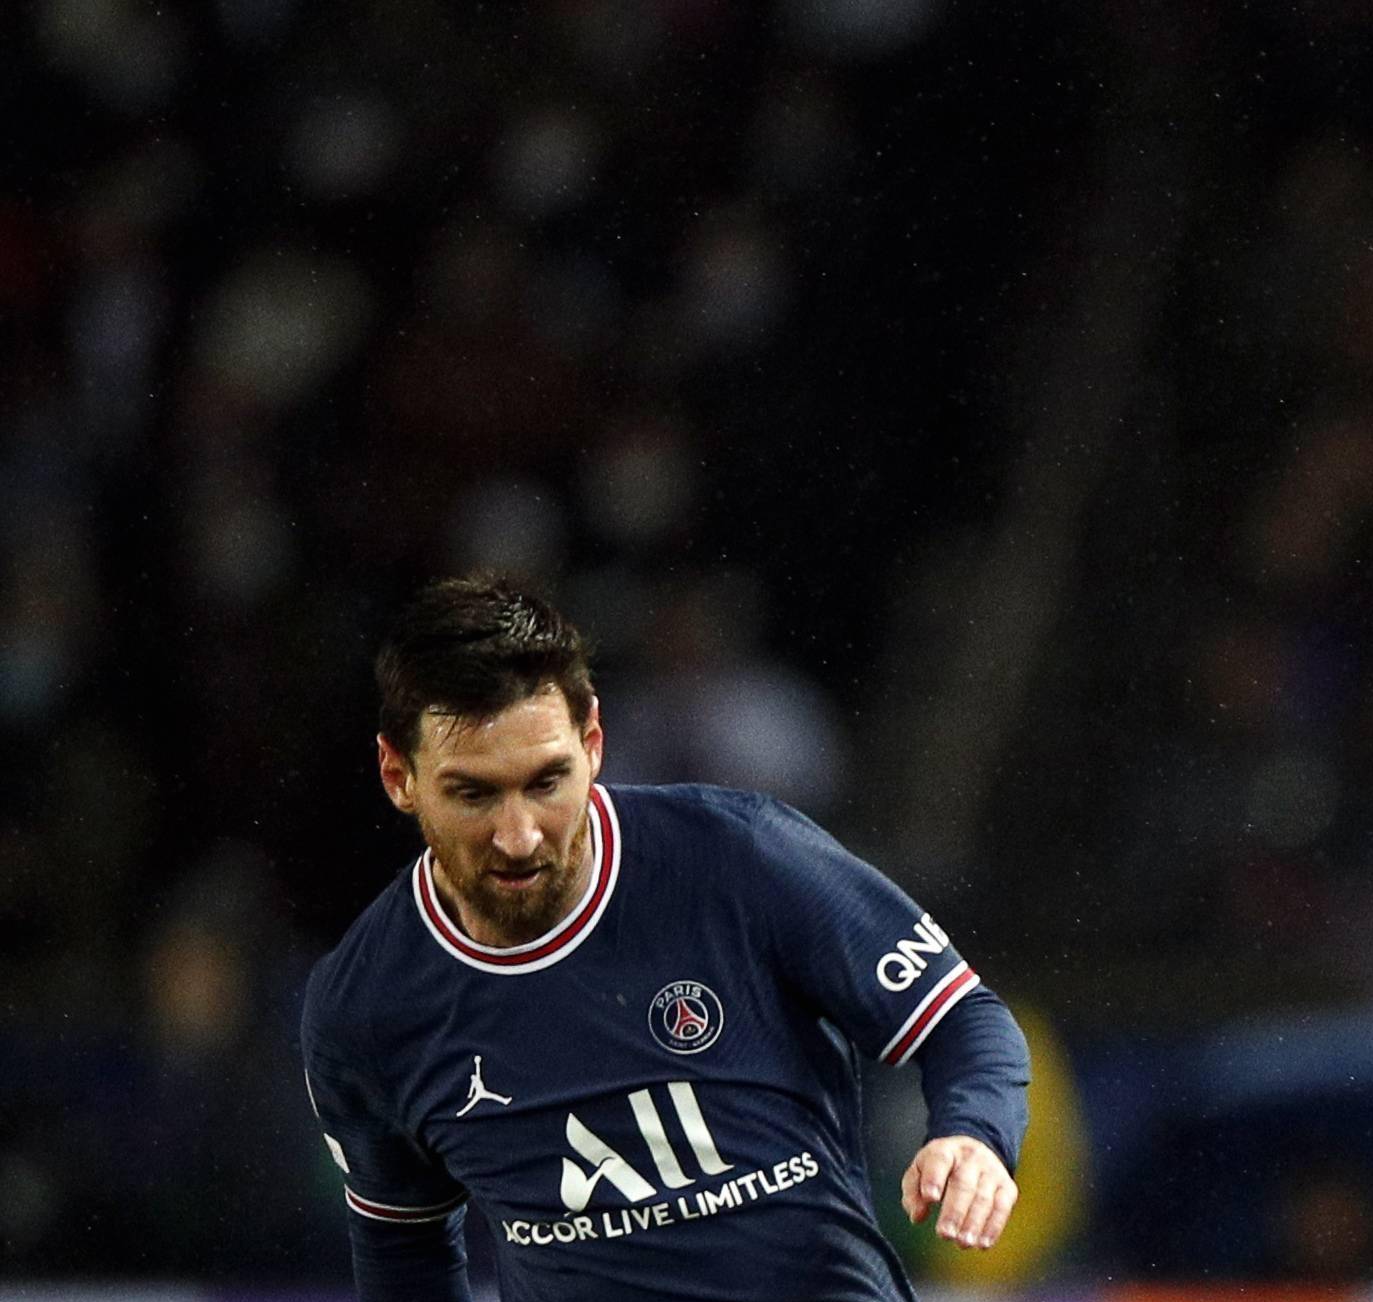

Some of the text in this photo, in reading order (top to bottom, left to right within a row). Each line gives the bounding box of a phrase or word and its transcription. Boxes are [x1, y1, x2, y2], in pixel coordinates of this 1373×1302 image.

[656, 985, 702, 1009] PARIS
[502, 1151, 819, 1246] ACCOR LIVE LIMITLESS
